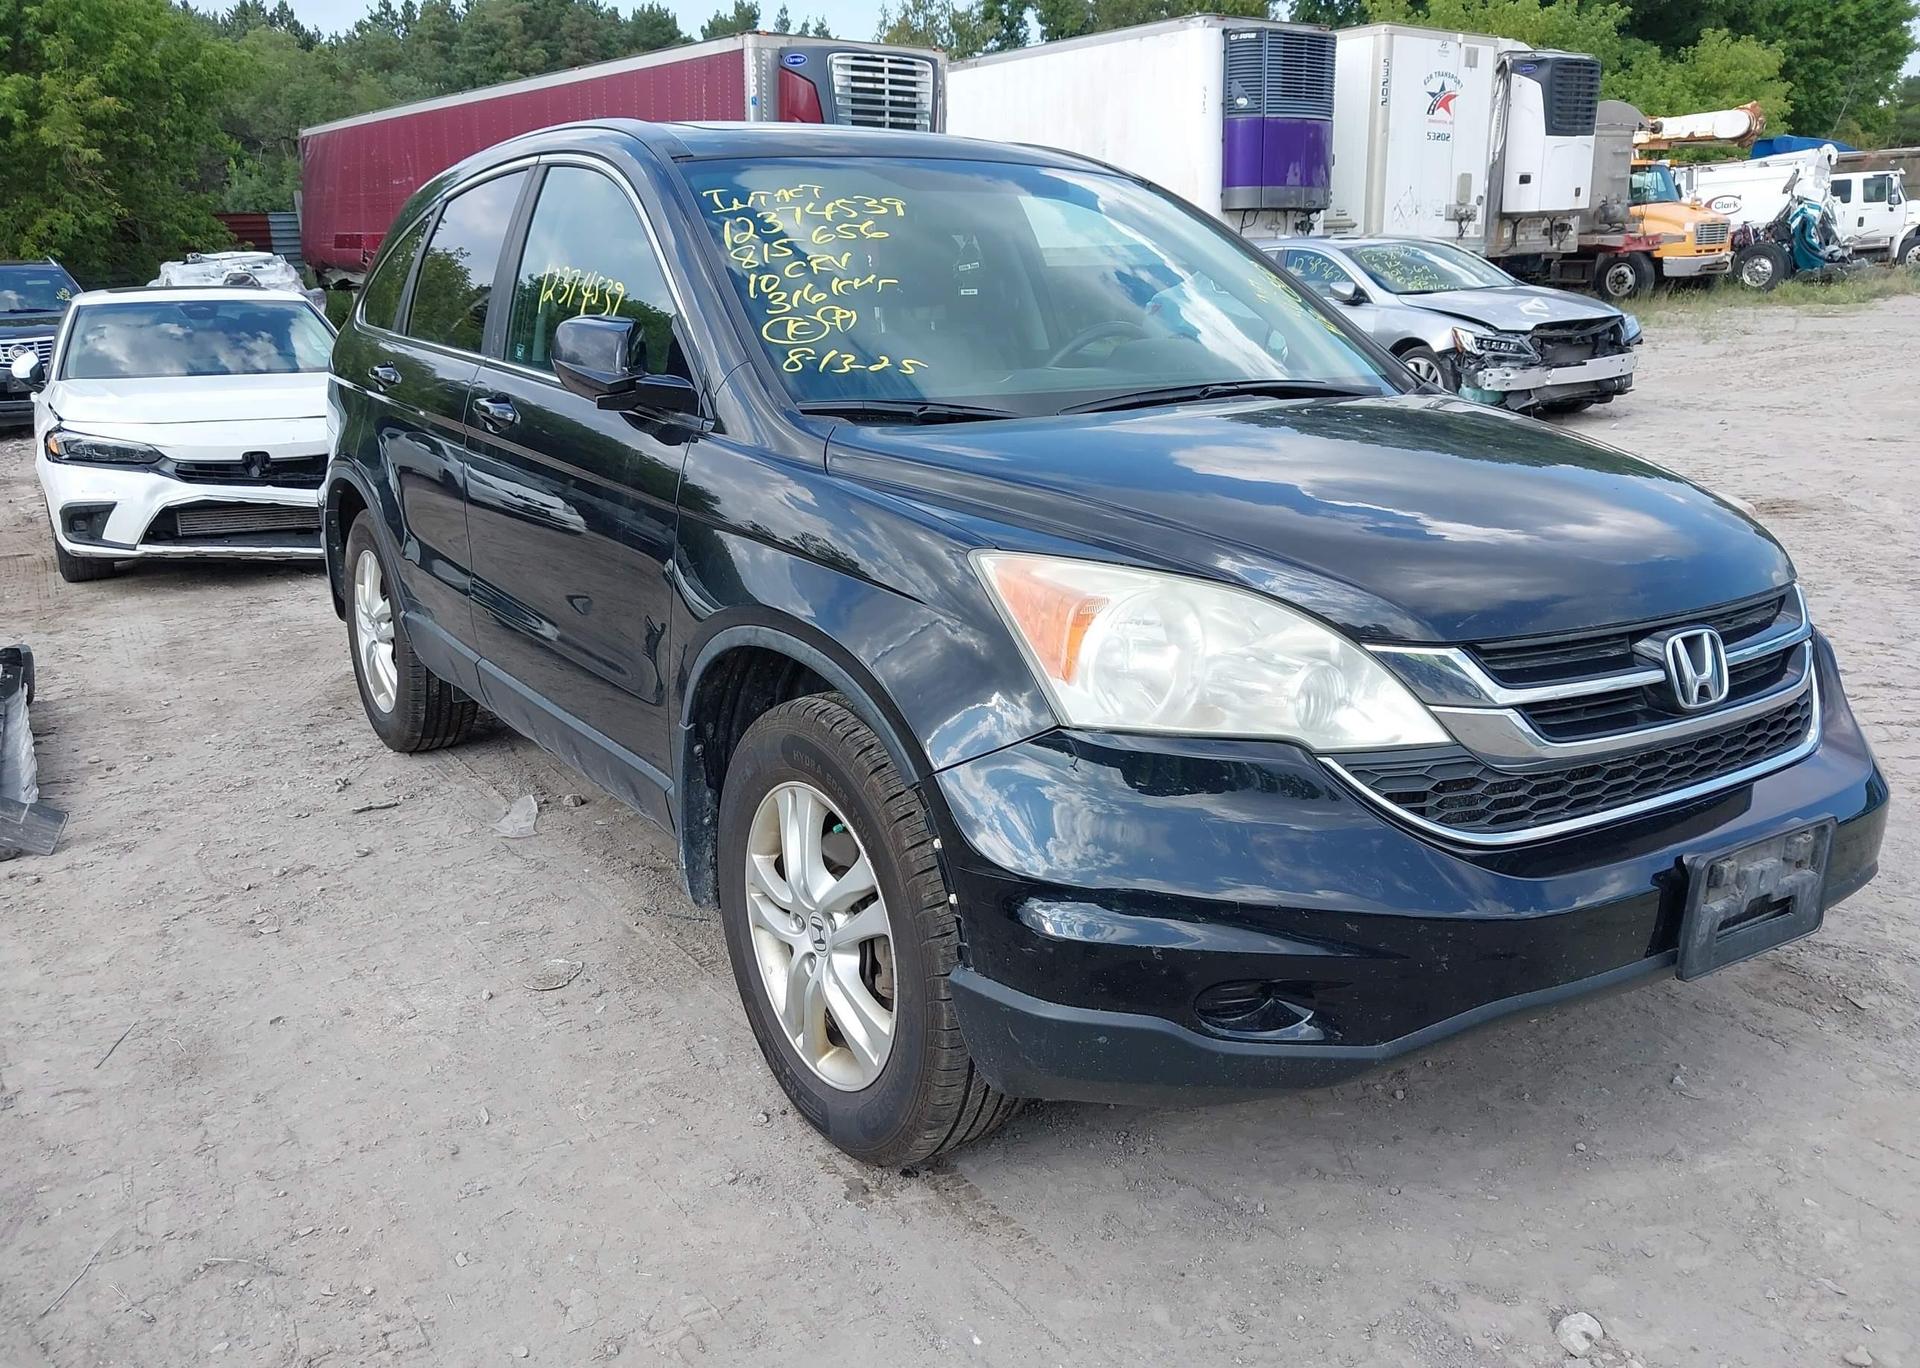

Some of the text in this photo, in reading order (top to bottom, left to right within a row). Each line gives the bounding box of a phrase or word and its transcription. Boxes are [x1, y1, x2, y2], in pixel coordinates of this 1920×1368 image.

[1381, 58, 1390, 107] 53202
[1434, 70, 1464, 89] TRANSPORT
[1426, 131, 1451, 142] 53202
[1714, 201, 1738, 209] Clark
[792, 749, 823, 775] HYDRA
